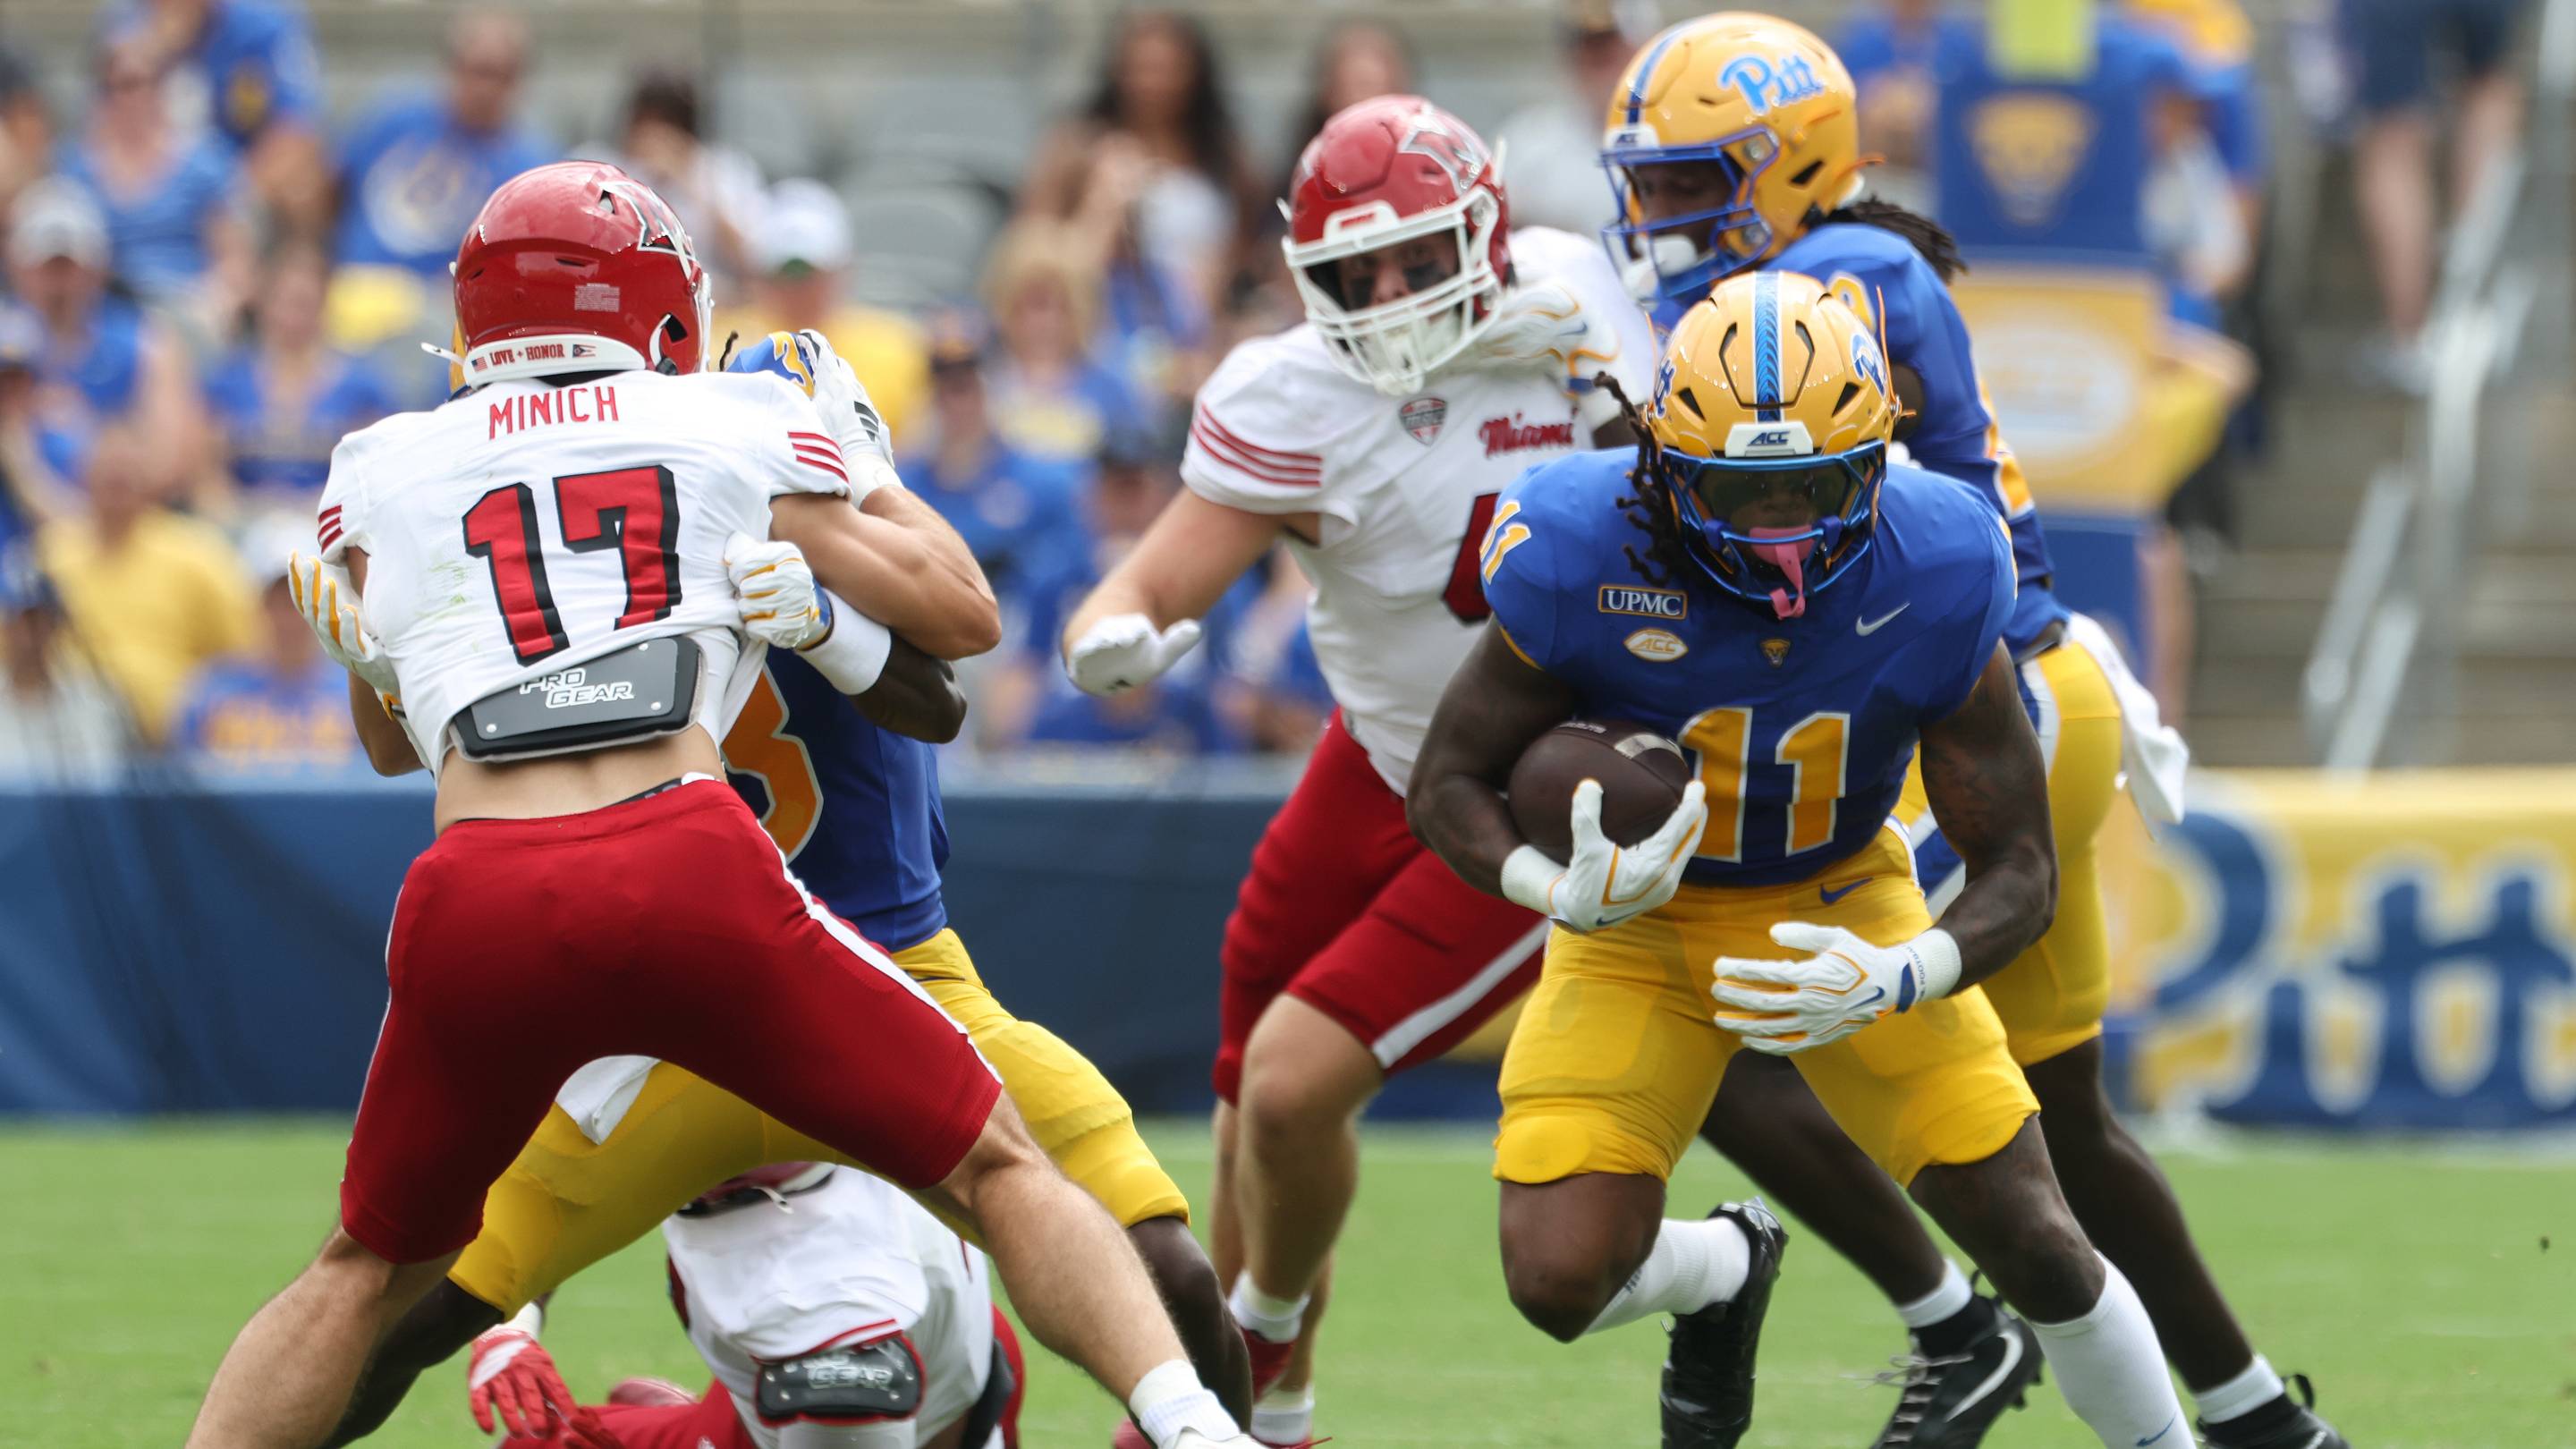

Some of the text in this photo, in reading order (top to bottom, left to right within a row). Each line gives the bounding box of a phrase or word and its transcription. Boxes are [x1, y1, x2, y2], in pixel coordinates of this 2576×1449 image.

[1718, 55, 1826, 116] Pitt
[489, 349, 515, 366] LOVE
[525, 343, 565, 361] HONOR
[488, 386, 620, 441] MINICH
[1478, 407, 1579, 459] Miami
[1746, 431, 1791, 446] ACC
[1479, 500, 1532, 586] 11
[462, 464, 682, 667] 17
[1606, 590, 1682, 616] UPMC
[1630, 638, 1675, 655] ACC
[520, 667, 586, 695] PRO
[546, 682, 635, 709] GEAR
[1677, 706, 1851, 864] 11
